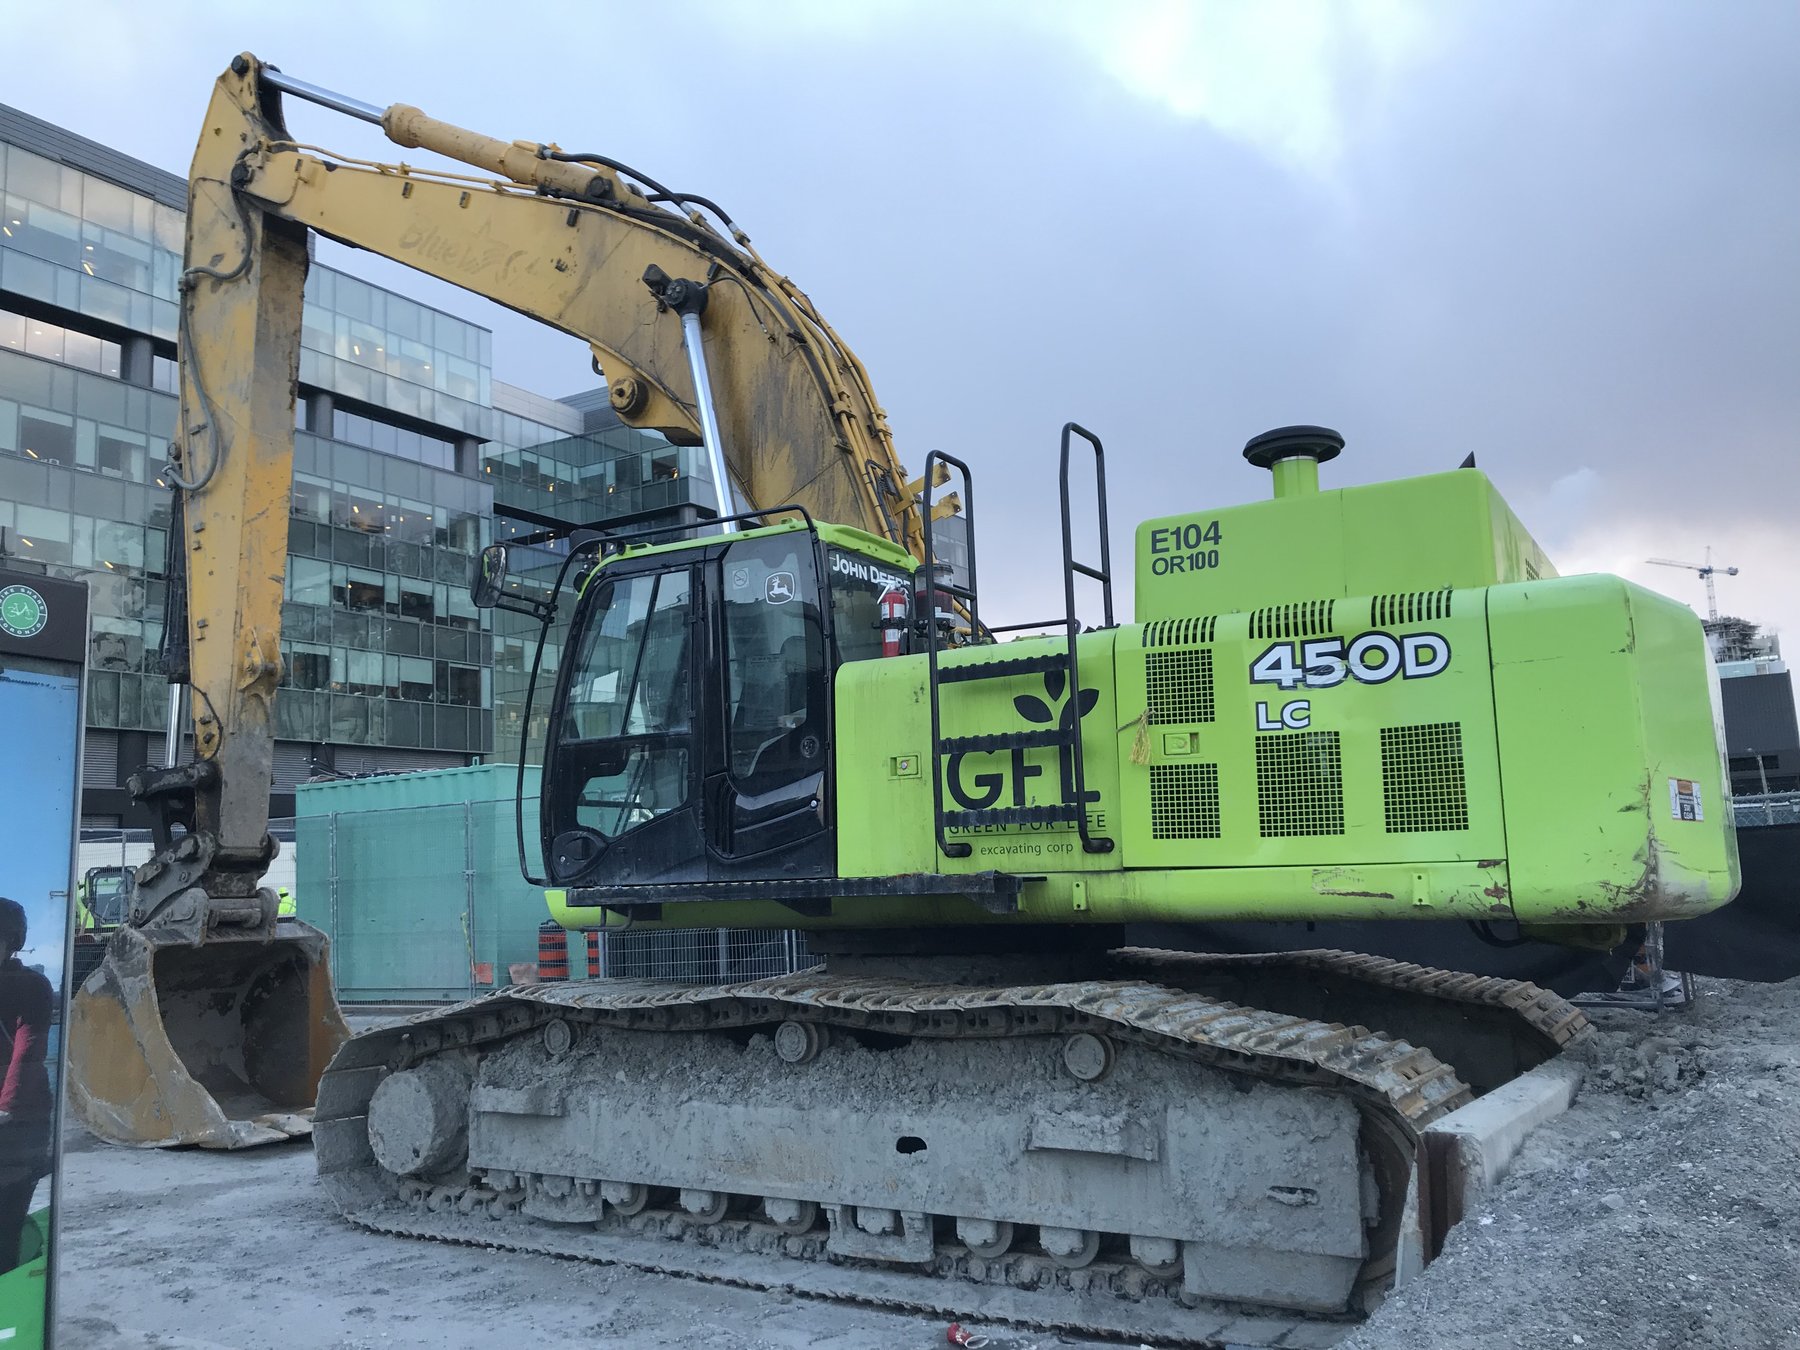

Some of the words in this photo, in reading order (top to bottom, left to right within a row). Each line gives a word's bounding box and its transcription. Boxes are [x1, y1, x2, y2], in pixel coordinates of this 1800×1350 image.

[1151, 520, 1222, 554] E104
[832, 553, 868, 581] JOHN
[1249, 630, 1452, 690] 450D
[1255, 699, 1311, 731] LC
[946, 742, 1101, 810] GFL
[1067, 814, 1106, 829] LFE
[980, 843, 1042, 856] excavating
[1046, 842, 1074, 855] corp
